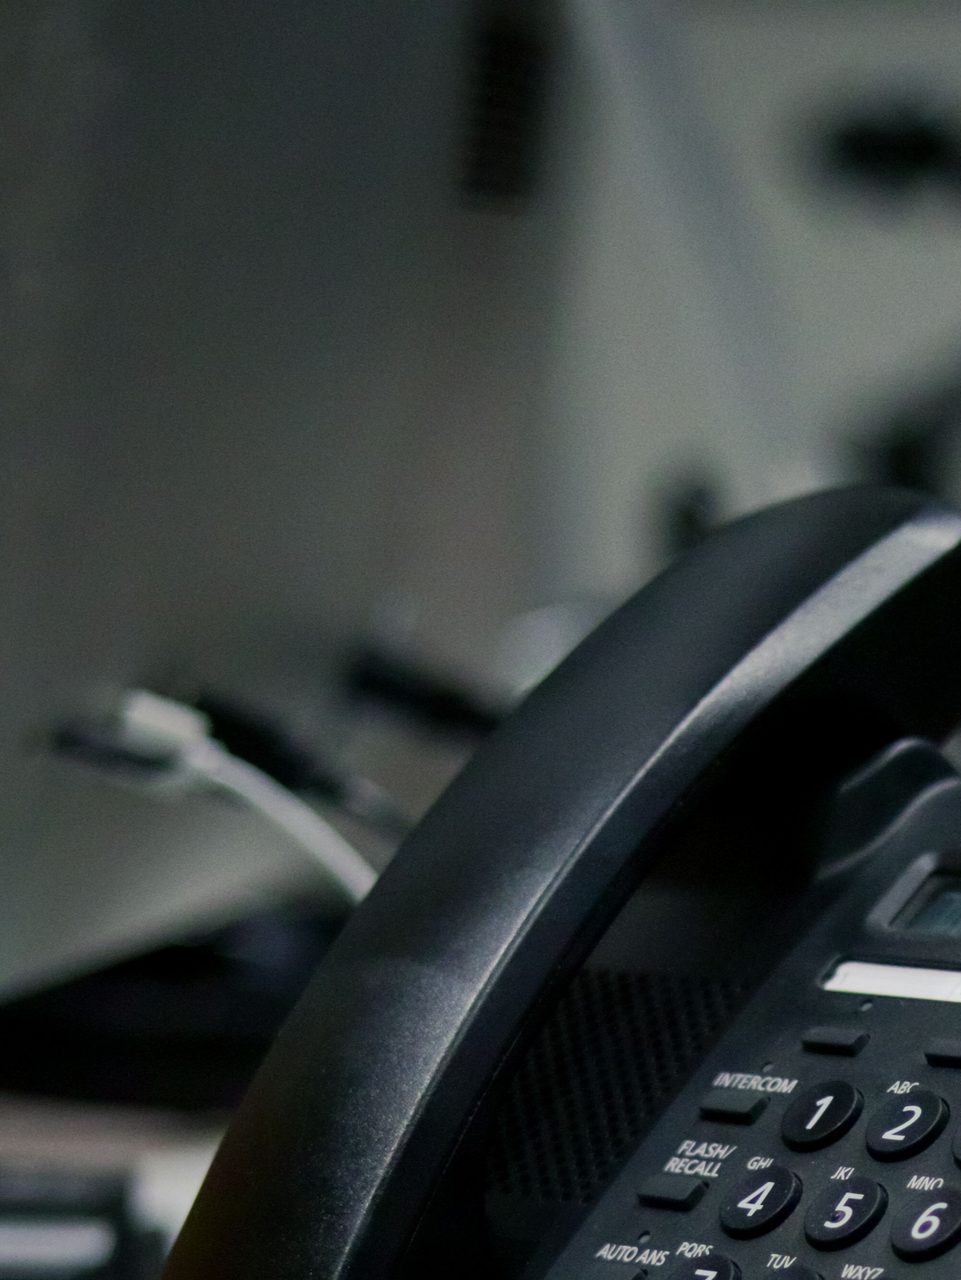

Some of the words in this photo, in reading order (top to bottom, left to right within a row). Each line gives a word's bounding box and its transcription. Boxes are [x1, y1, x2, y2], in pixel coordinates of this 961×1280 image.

[713, 1072, 798, 1094] INTERCOM
[805, 1095, 834, 1130] 1
[881, 1105, 922, 1141] 2
[677, 1140, 737, 1159] FLASH/
[664, 1157, 722, 1178] RECALL
[746, 1156, 774, 1171] GHI
[737, 1181, 775, 1217] 4
[823, 1192, 865, 1229] 5
[910, 1201, 949, 1240] 6
[595, 1243, 640, 1263] AUTO
[636, 1248, 670, 1266] ANS
[765, 1253, 797, 1270] TUV
